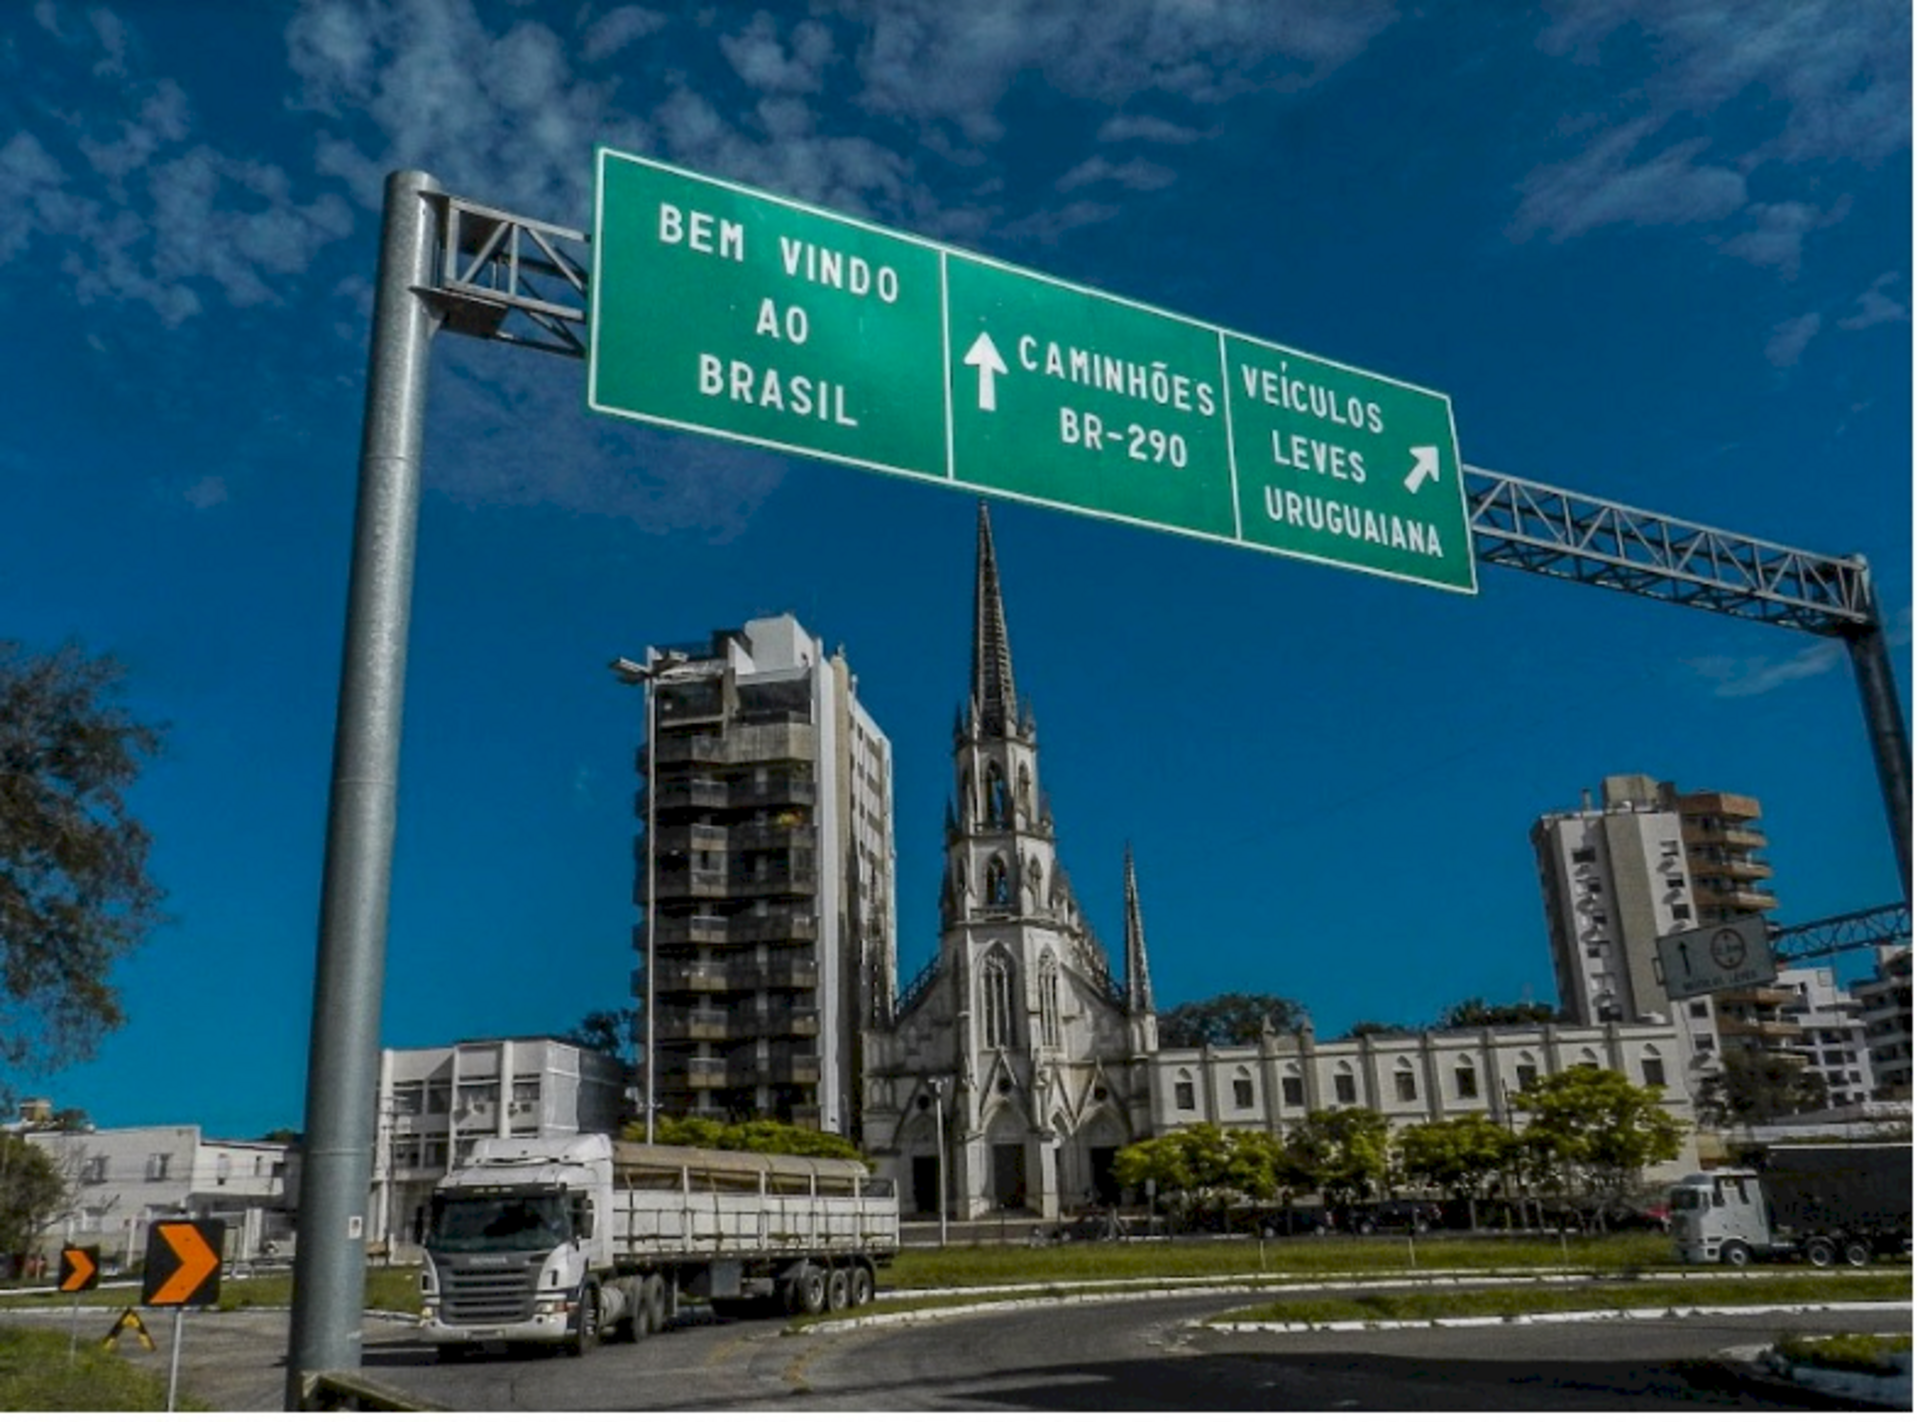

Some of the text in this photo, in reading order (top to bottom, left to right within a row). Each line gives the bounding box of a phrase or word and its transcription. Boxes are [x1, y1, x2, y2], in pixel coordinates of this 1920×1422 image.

[658, 202, 900, 304] BEM VINDO
[755, 297, 809, 345] AO
[699, 352, 857, 428] BRASIL
[1018, 334, 1216, 417] CAMINHÕES
[1241, 362, 1385, 434] VEÍCULOS
[1059, 406, 1188, 469] BR-290
[1272, 429, 1367, 484] LEVES
[1264, 485, 1444, 558] URUGUAIANA
